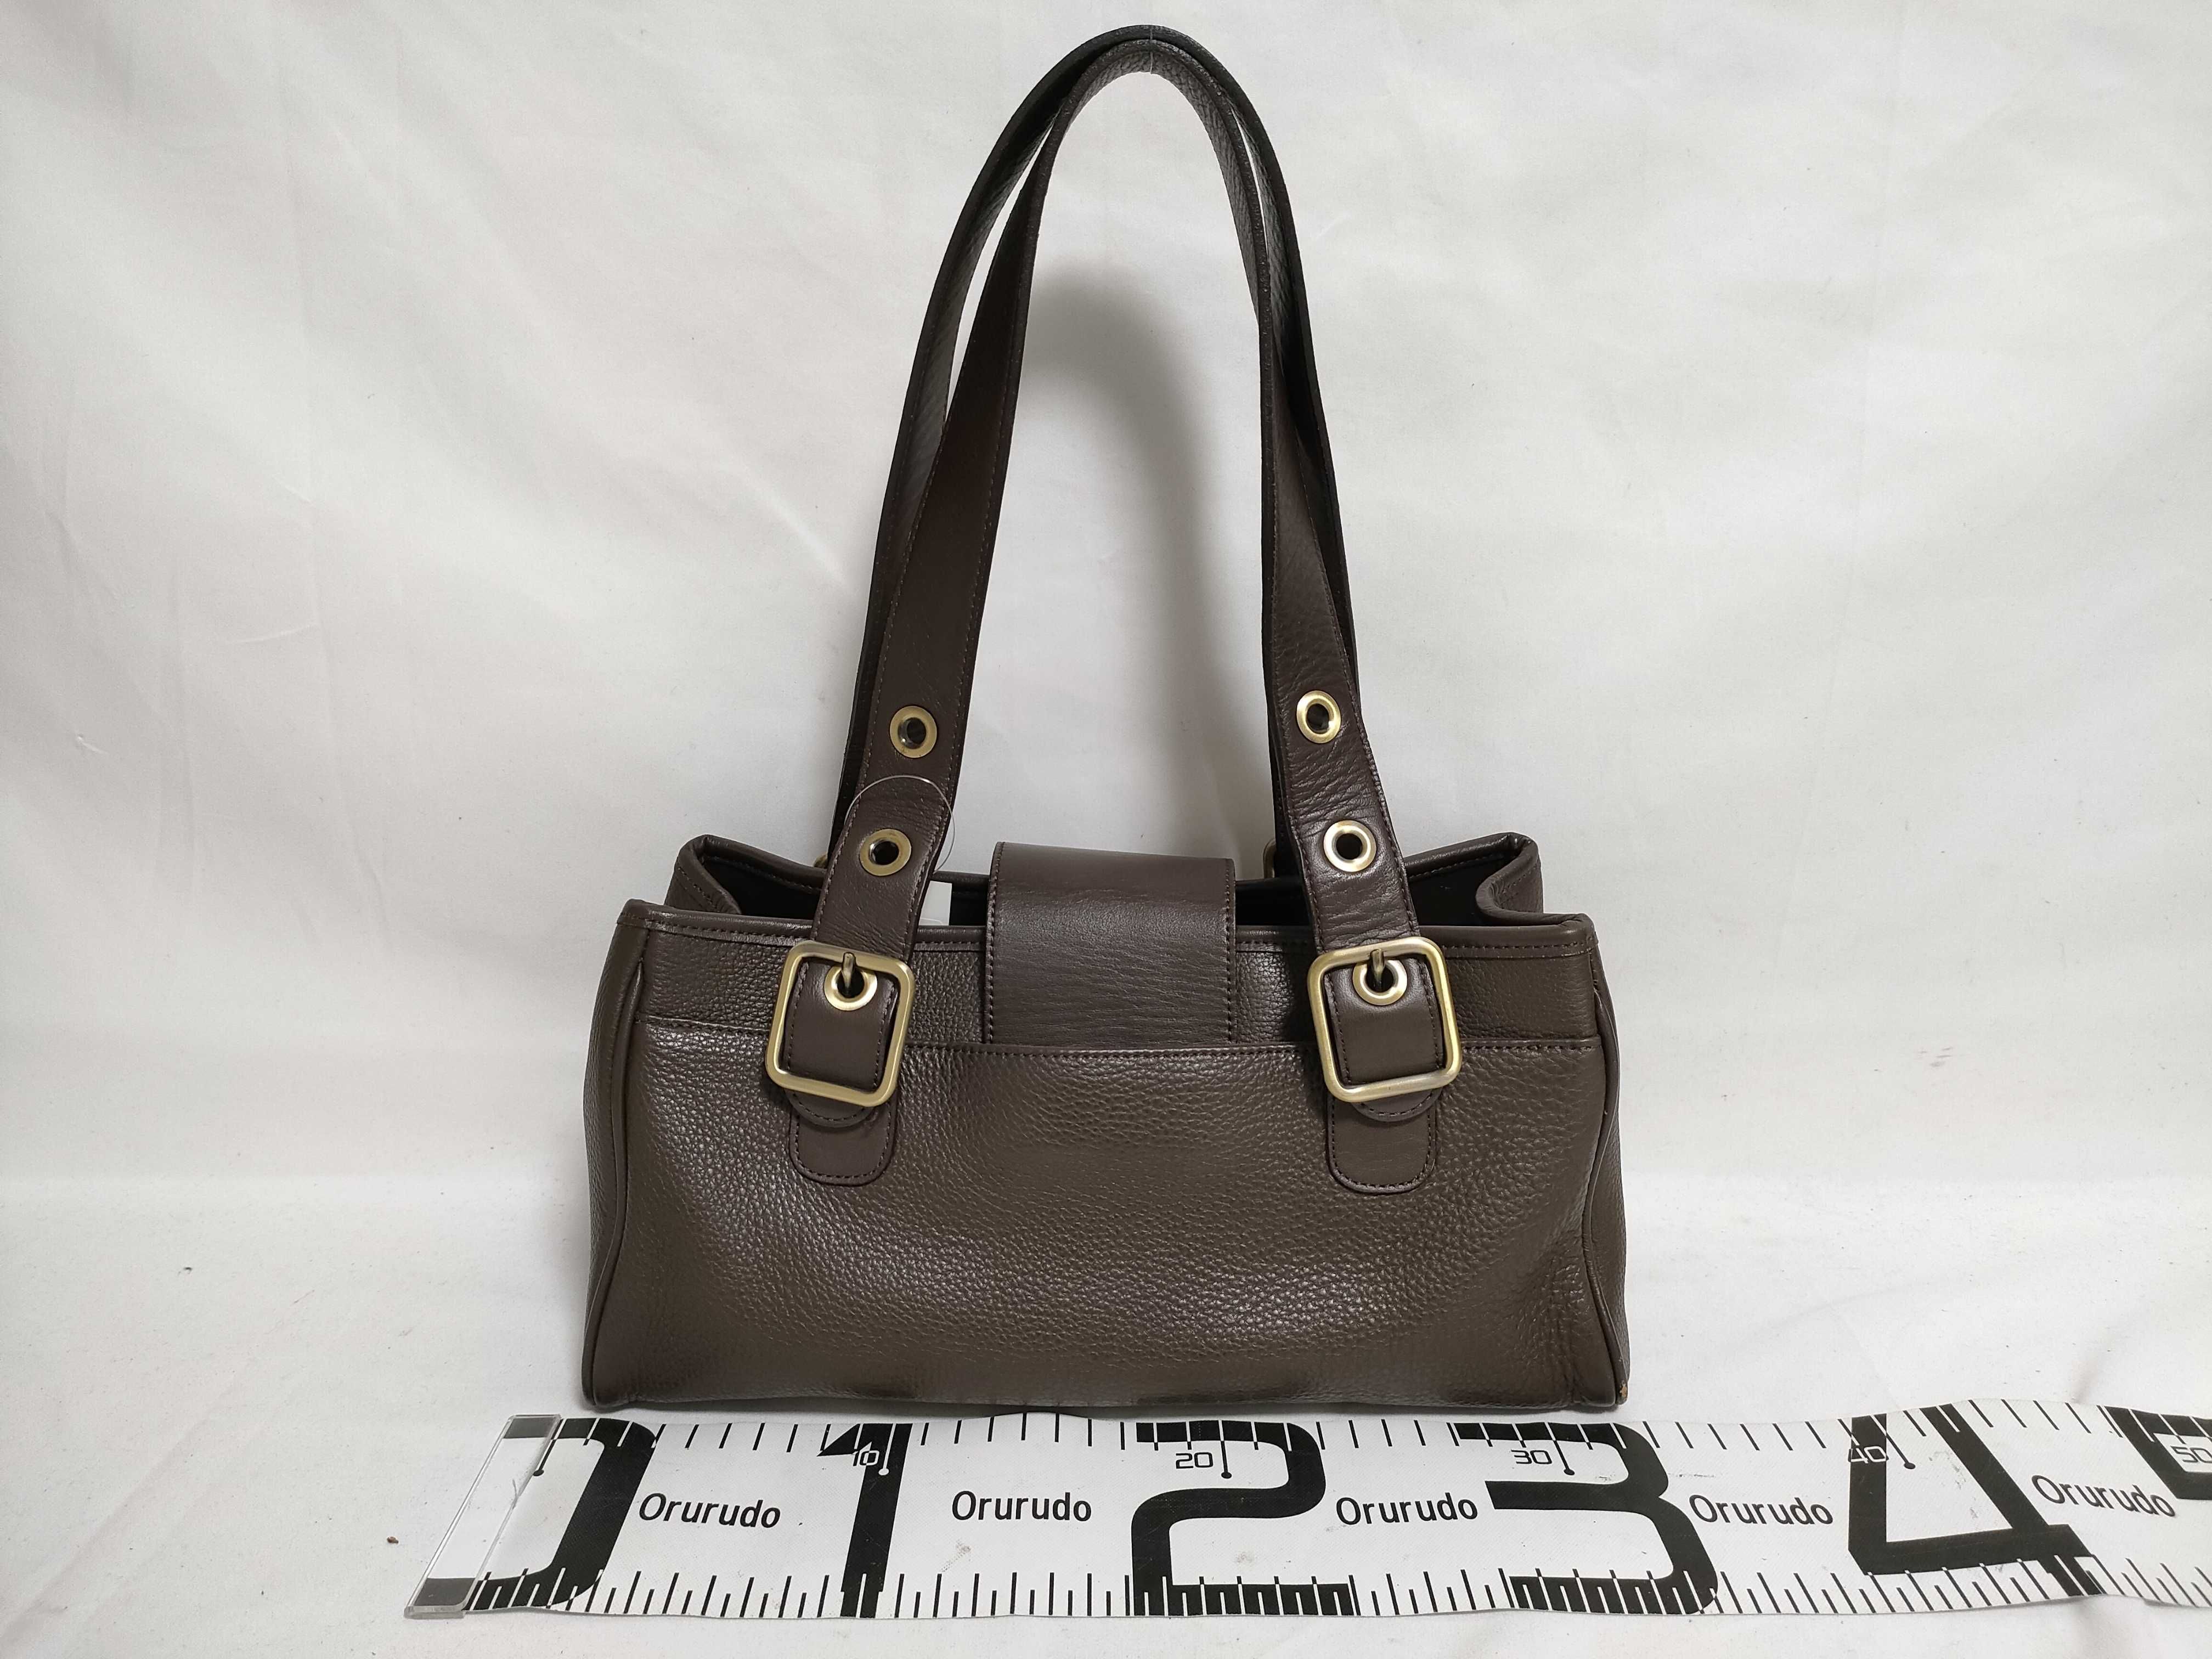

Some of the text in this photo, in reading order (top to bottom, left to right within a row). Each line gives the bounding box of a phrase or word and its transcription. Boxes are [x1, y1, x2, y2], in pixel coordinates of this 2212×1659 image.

[851, 1450, 880, 1466] 10
[1175, 1451, 1214, 1469] 20
[1510, 1448, 1552, 1466] 30
[1848, 1446, 1889, 1464] 40
[2170, 1445, 2212, 1464] 50
[639, 1492, 782, 1528] Orurudo
[951, 1490, 1093, 1522] Orurudo
[1335, 1492, 1479, 1526] Orurudo
[1689, 1494, 1834, 1525] Orurudo
[1848, 1403, 2104, 1596] 4
[2032, 1474, 2176, 1518] Orurudo
[816, 1423, 913, 1618] 1
[1131, 1420, 1348, 1617] 2
[1454, 1421, 1718, 1615] 3
